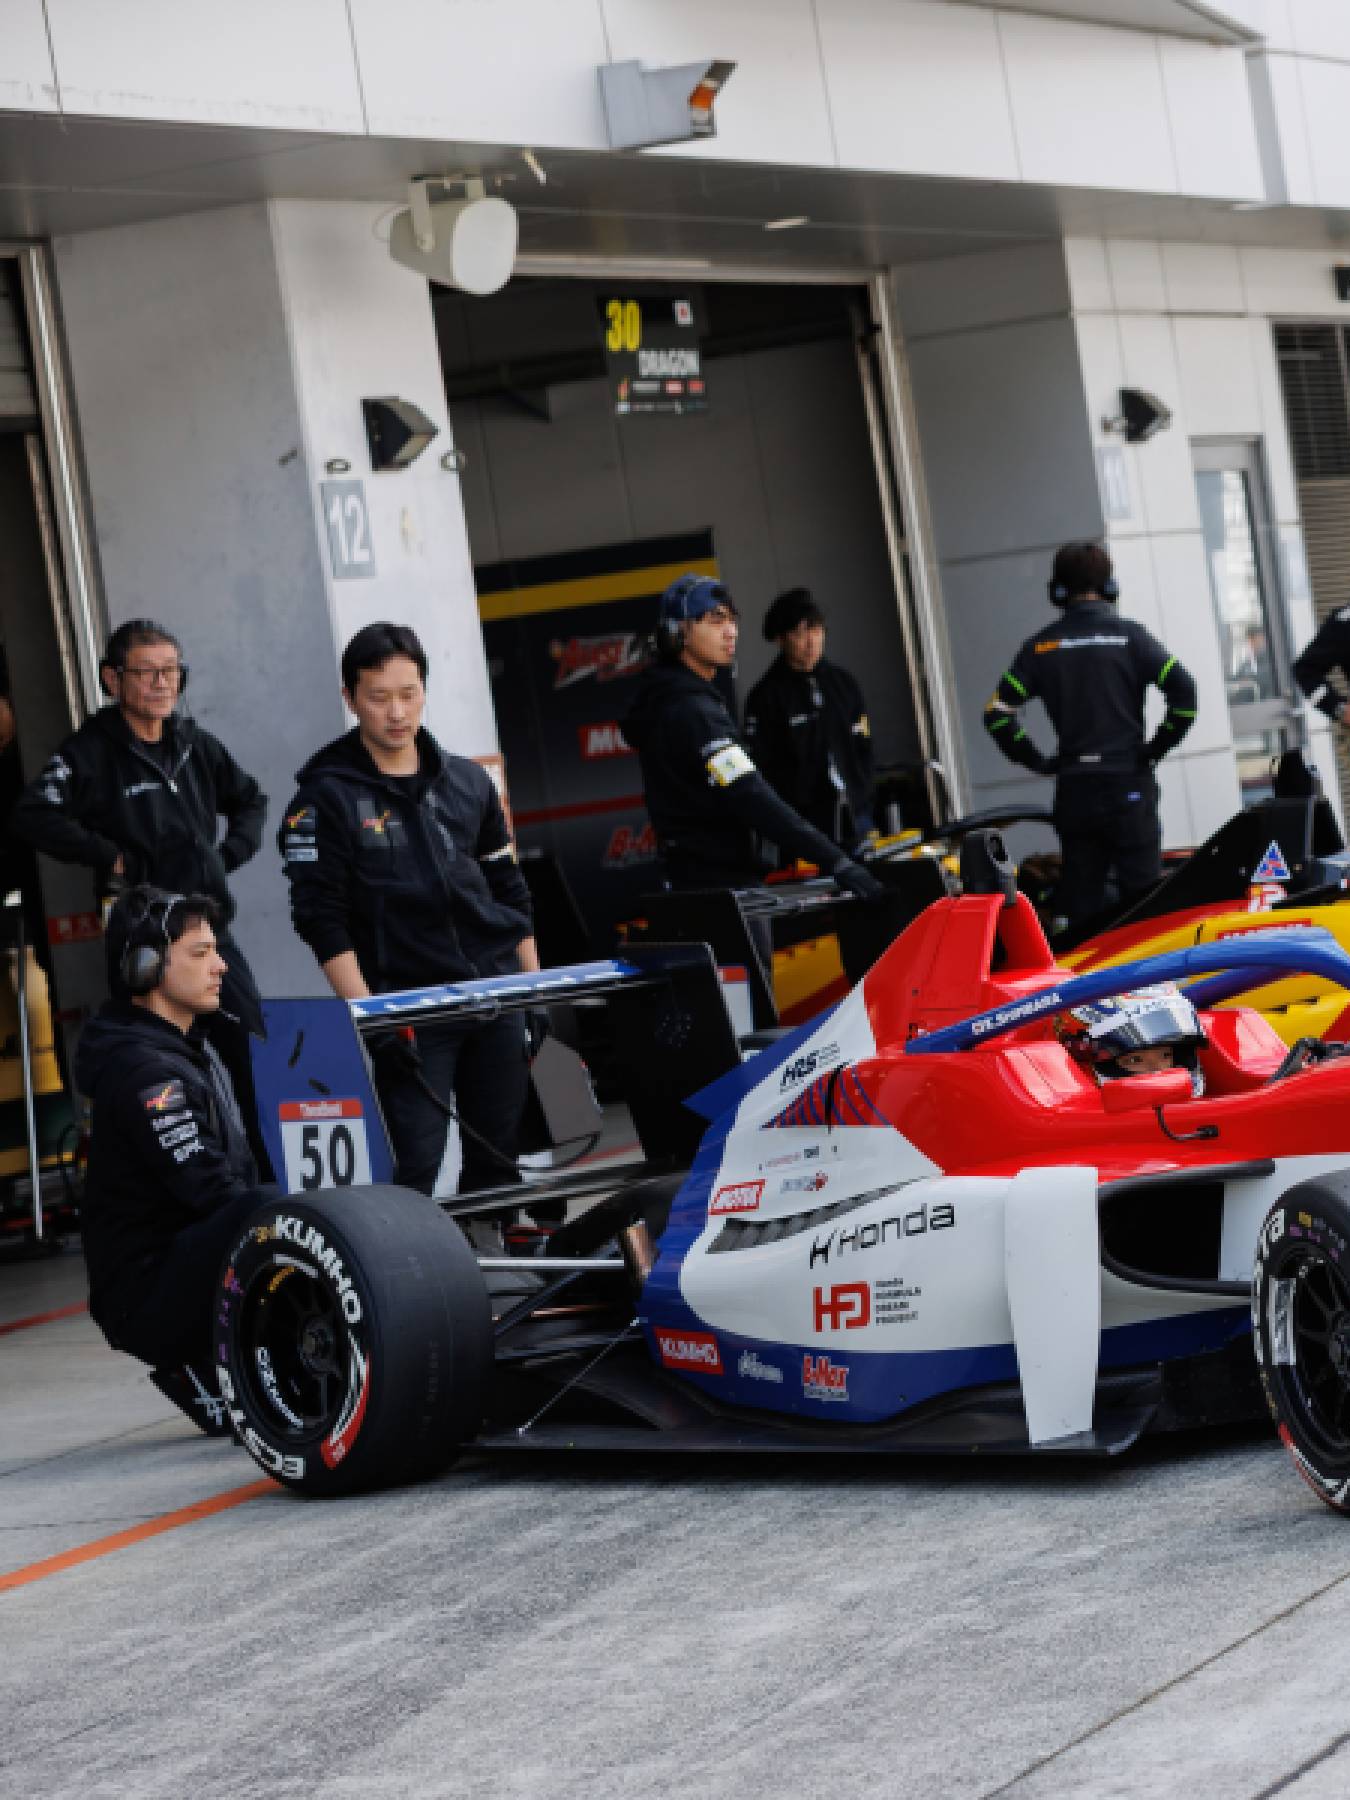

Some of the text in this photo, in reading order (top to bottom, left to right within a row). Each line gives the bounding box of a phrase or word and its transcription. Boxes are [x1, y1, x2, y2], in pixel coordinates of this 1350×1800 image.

[606, 299, 642, 352] 30
[639, 349, 700, 377] DRAGON
[329, 494, 370, 564] 12
[301, 1124, 355, 1192] 50
[836, 1202, 956, 1258] Honda
[274, 1214, 362, 1323] KUMHO
[660, 1337, 717, 1366] KUMHO
